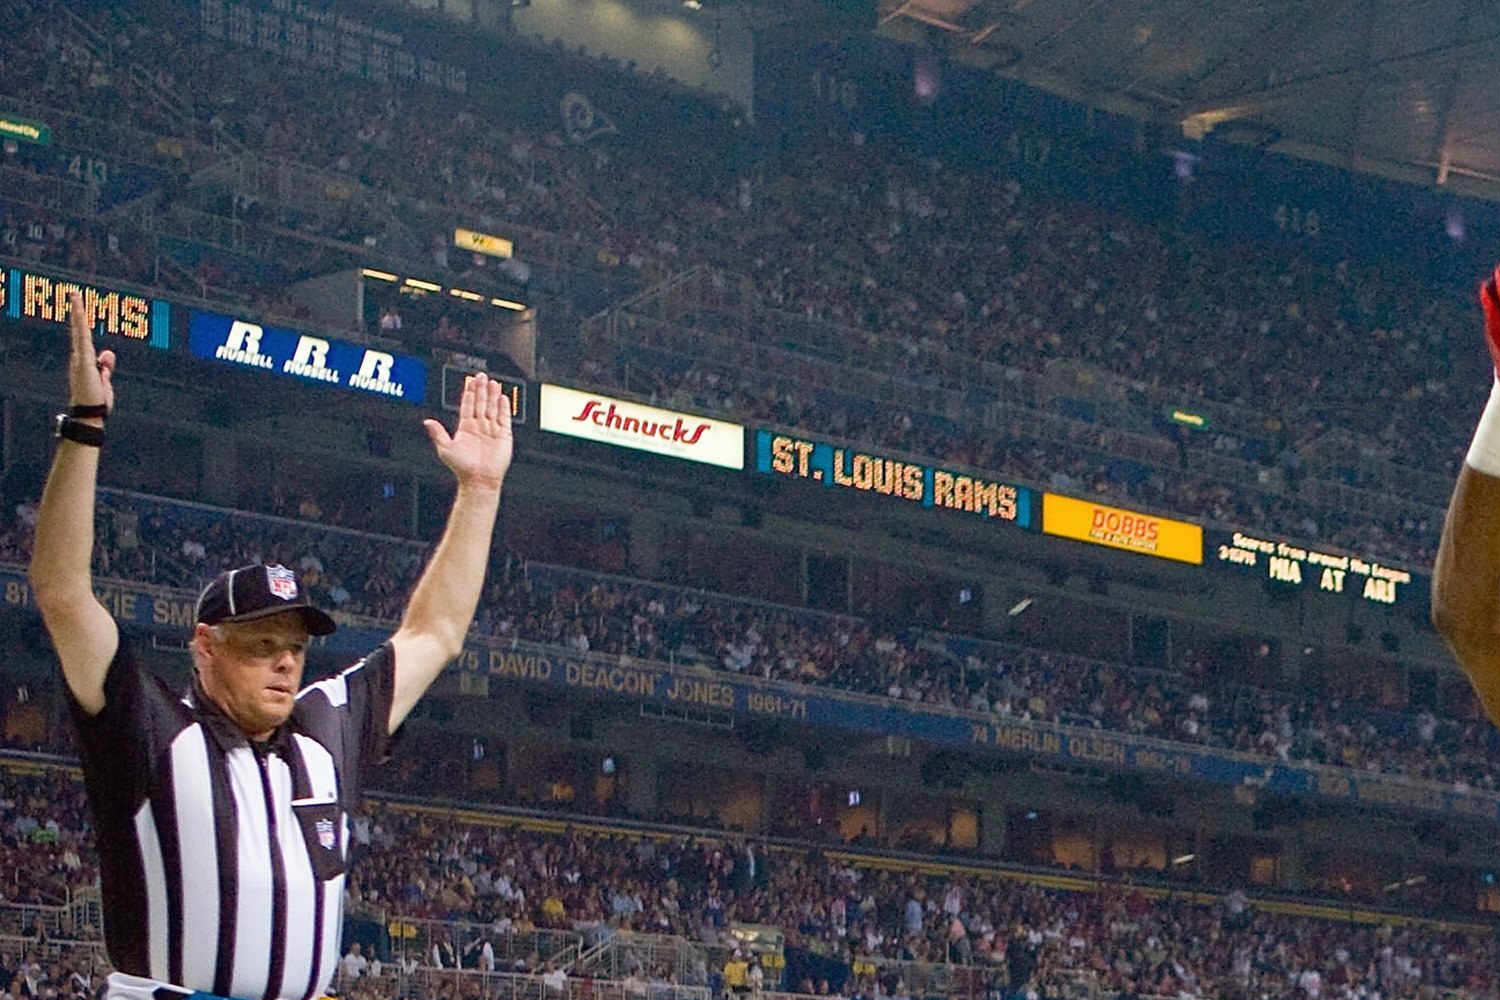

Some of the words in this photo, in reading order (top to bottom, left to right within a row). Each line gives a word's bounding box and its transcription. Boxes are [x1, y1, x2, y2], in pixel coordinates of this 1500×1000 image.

[24, 274, 149, 339] RAMS
[572, 401, 711, 445] Schnucks
[772, 437, 822, 481] ST.
[834, 450, 923, 500] LOUIS
[934, 471, 1017, 521] RAMS
[1092, 508, 1159, 540] DOBBS
[6, 581, 28, 606] 81
[1269, 556, 1302, 584] MIA
[1320, 568, 1346, 593] AT
[489, 651, 551, 681] DAVID
[667, 677, 734, 709] JONES
[995, 727, 1060, 753] MERLIN
[1069, 736, 1126, 763] OLSEN
